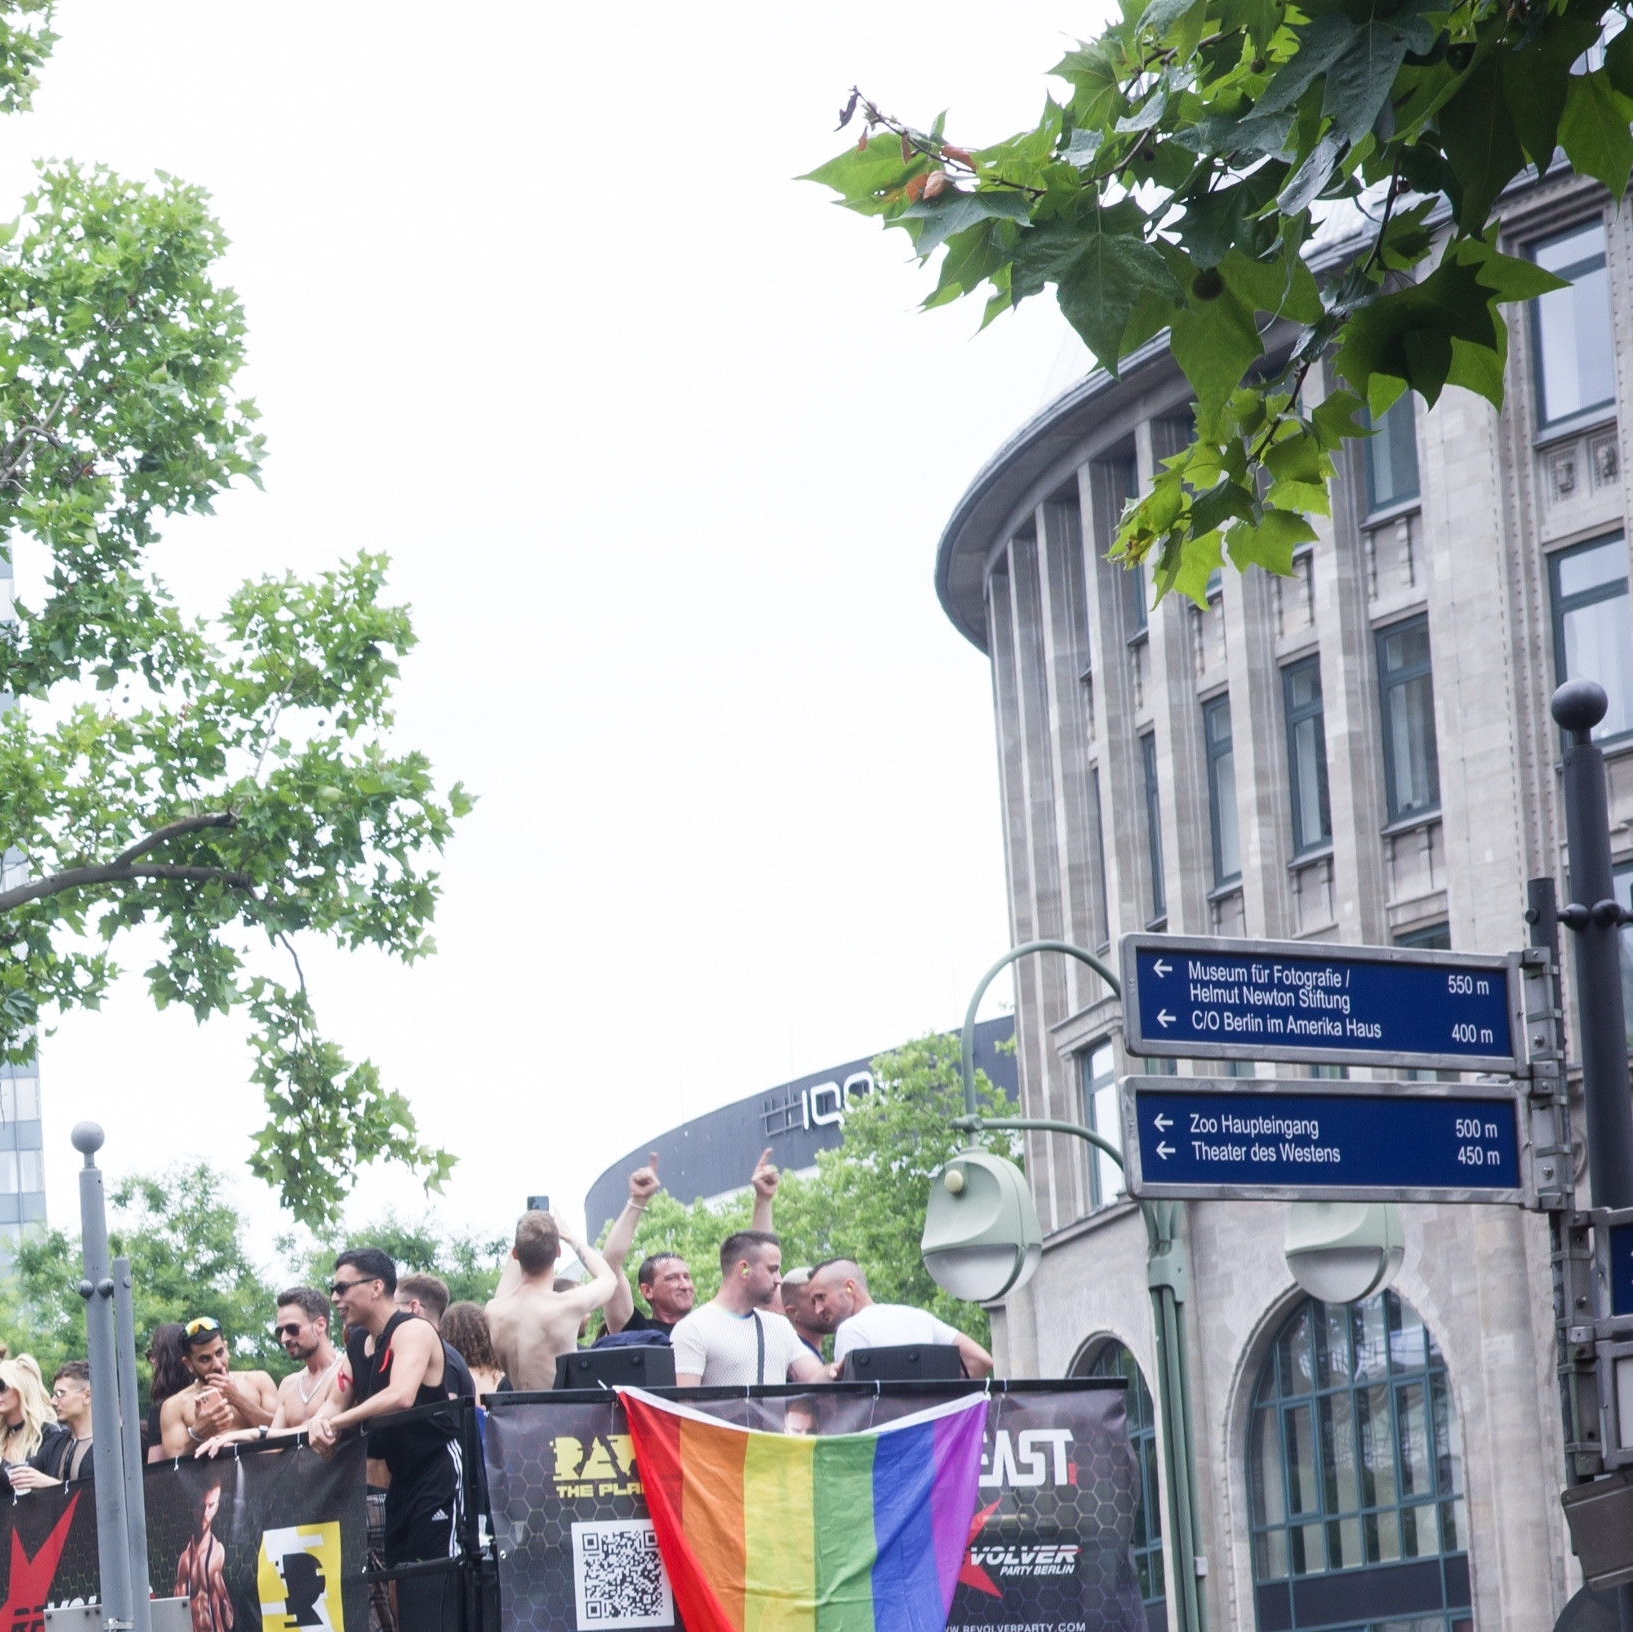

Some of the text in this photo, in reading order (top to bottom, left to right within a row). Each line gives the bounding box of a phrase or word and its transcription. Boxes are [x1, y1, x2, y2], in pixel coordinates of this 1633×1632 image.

[1188, 960, 1247, 983] Museum
[1252, 963, 1272, 984] für
[1274, 966, 1342, 992] Fotografie
[1448, 975, 1490, 995] 550 m
[1190, 984, 1351, 1014] Helmut Newton Stiftung
[1192, 1010, 1382, 1039] C/O Berlin im Amerika Haus
[1452, 1024, 1493, 1044] 400 m
[1190, 1114, 1319, 1139] Zoo Haupteingang
[1455, 1119, 1498, 1138] 500 m
[1192, 1141, 1340, 1163] Theater des Westens
[1458, 1146, 1500, 1166] 450 m
[556, 1482, 645, 1499] THE PLA
[968, 1544, 1080, 1567] VOLVER
[1000, 1563, 1075, 1577] PARTY BERLIN
